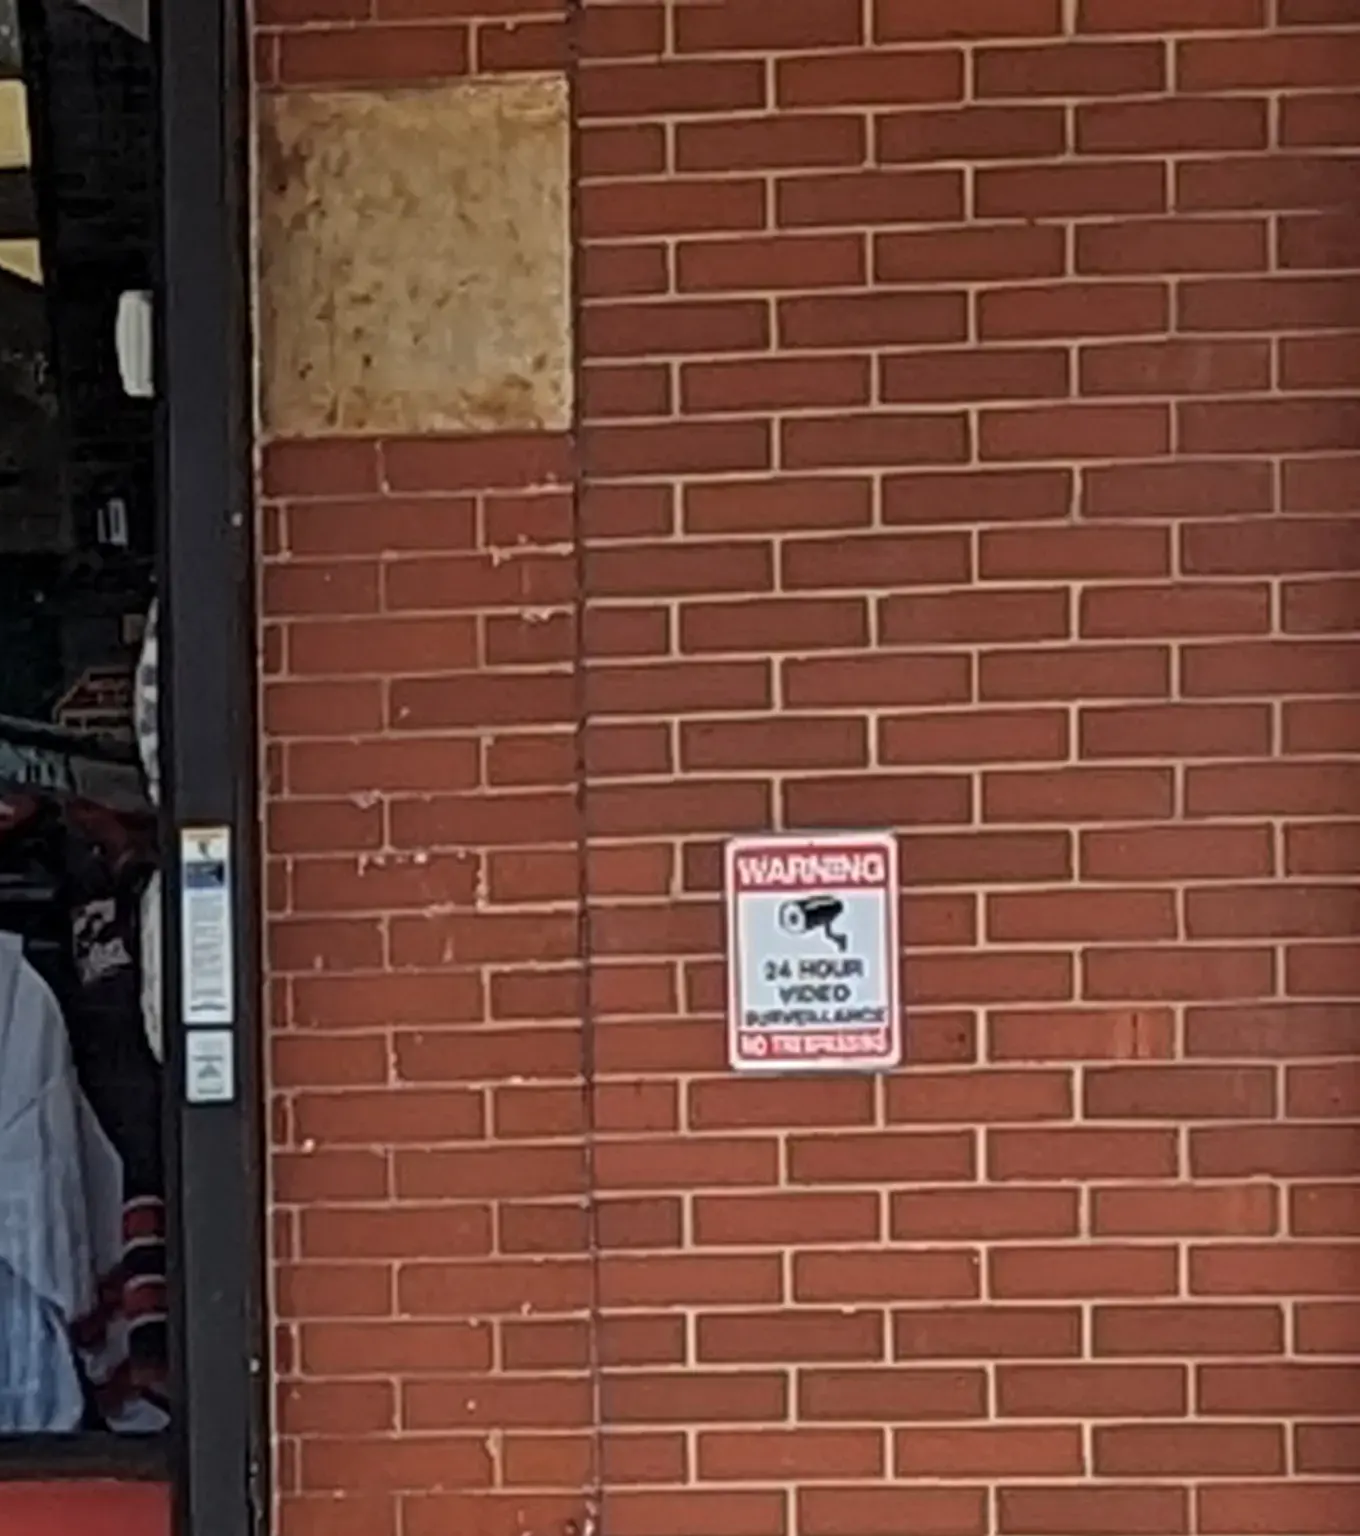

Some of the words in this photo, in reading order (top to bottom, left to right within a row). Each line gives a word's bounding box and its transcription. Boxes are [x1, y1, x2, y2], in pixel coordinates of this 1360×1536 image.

[737, 852, 885, 886] WARNING
[764, 960, 792, 982] 24
[798, 958, 865, 981] HOUR
[778, 985, 853, 1005] VIDEO
